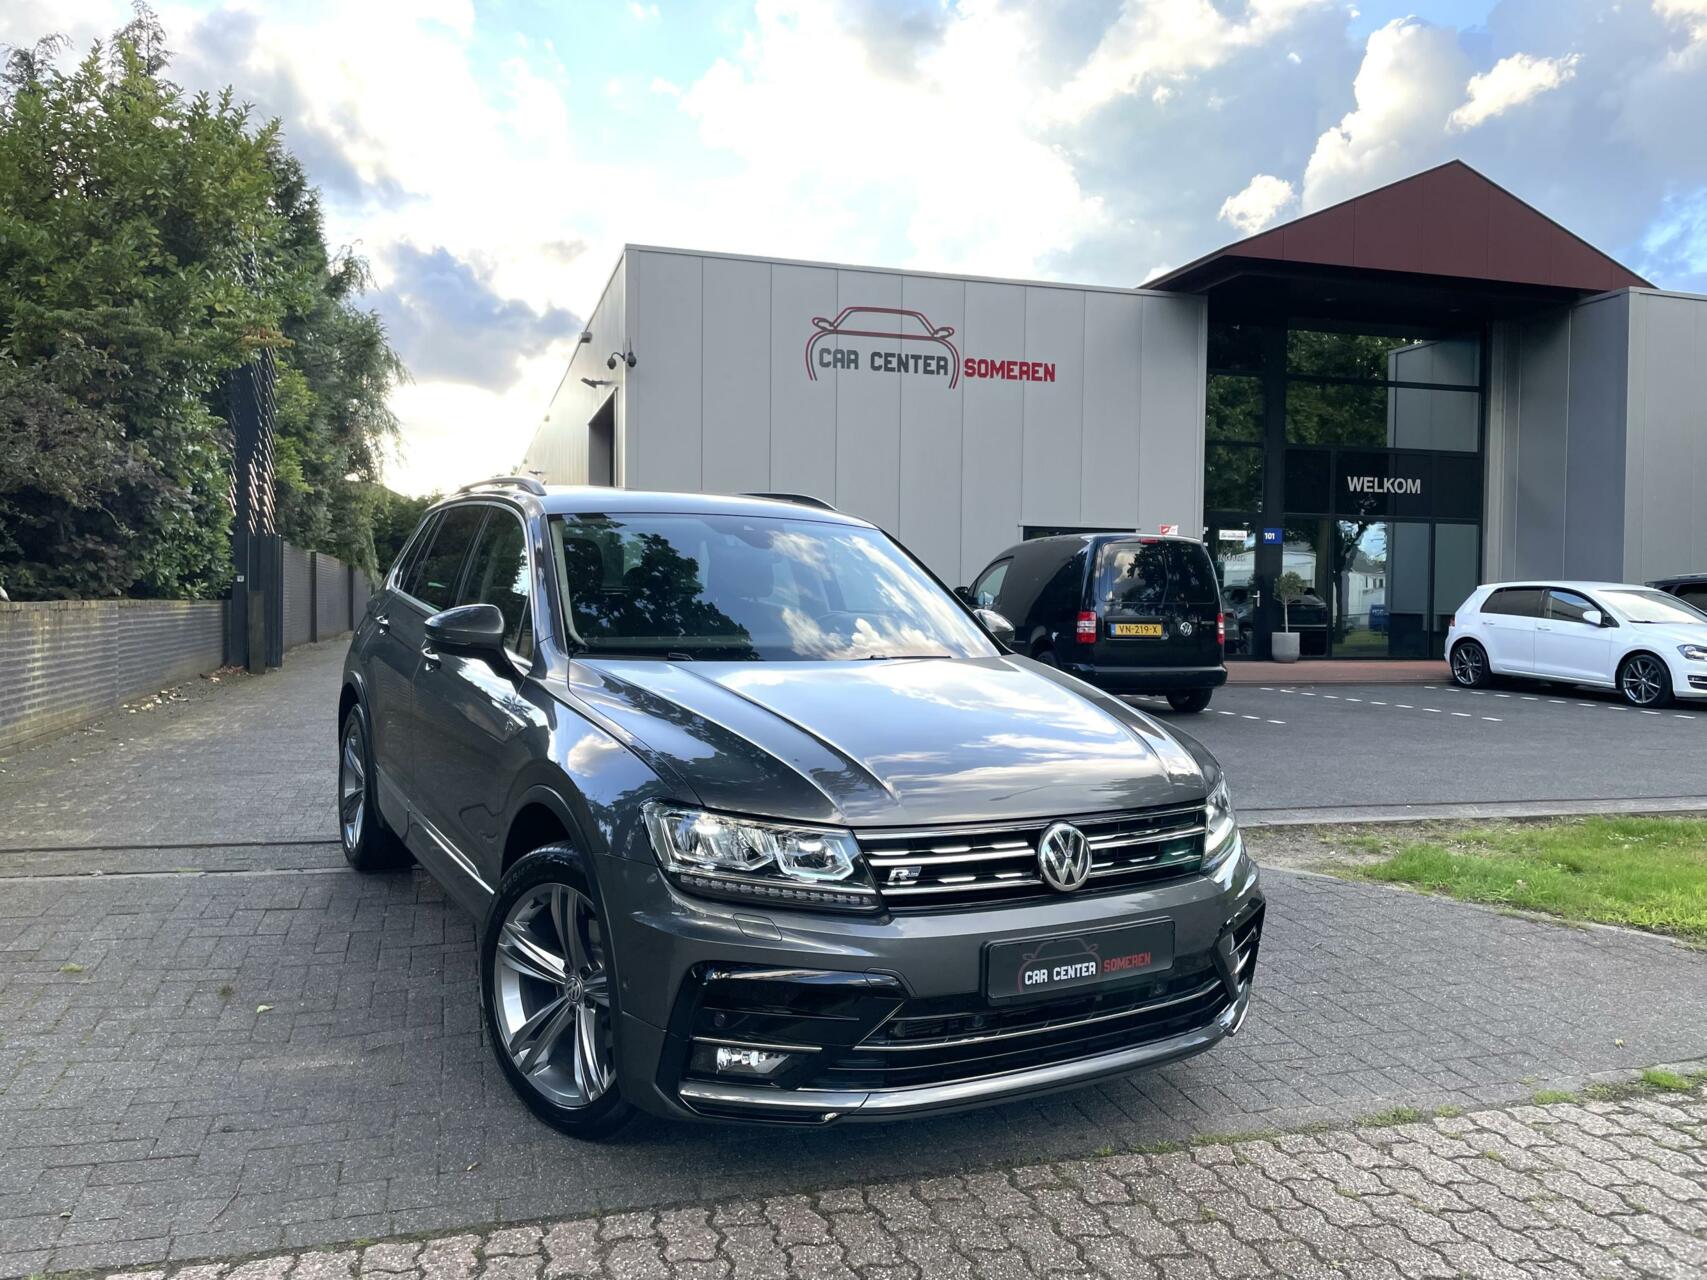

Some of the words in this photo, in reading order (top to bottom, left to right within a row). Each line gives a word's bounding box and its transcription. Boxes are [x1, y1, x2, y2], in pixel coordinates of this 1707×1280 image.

[819, 348, 859, 369] CAR
[870, 351, 948, 375] CENTER
[964, 358, 1055, 382] SOMEREN
[1347, 476, 1421, 494] WELKOM
[1264, 532, 1275, 540] 101
[1118, 624, 1158, 635] VN-219-X
[1024, 970, 1048, 985] CAR
[1053, 961, 1096, 981] CENTER
[1103, 952, 1151, 972] SOMEREN
